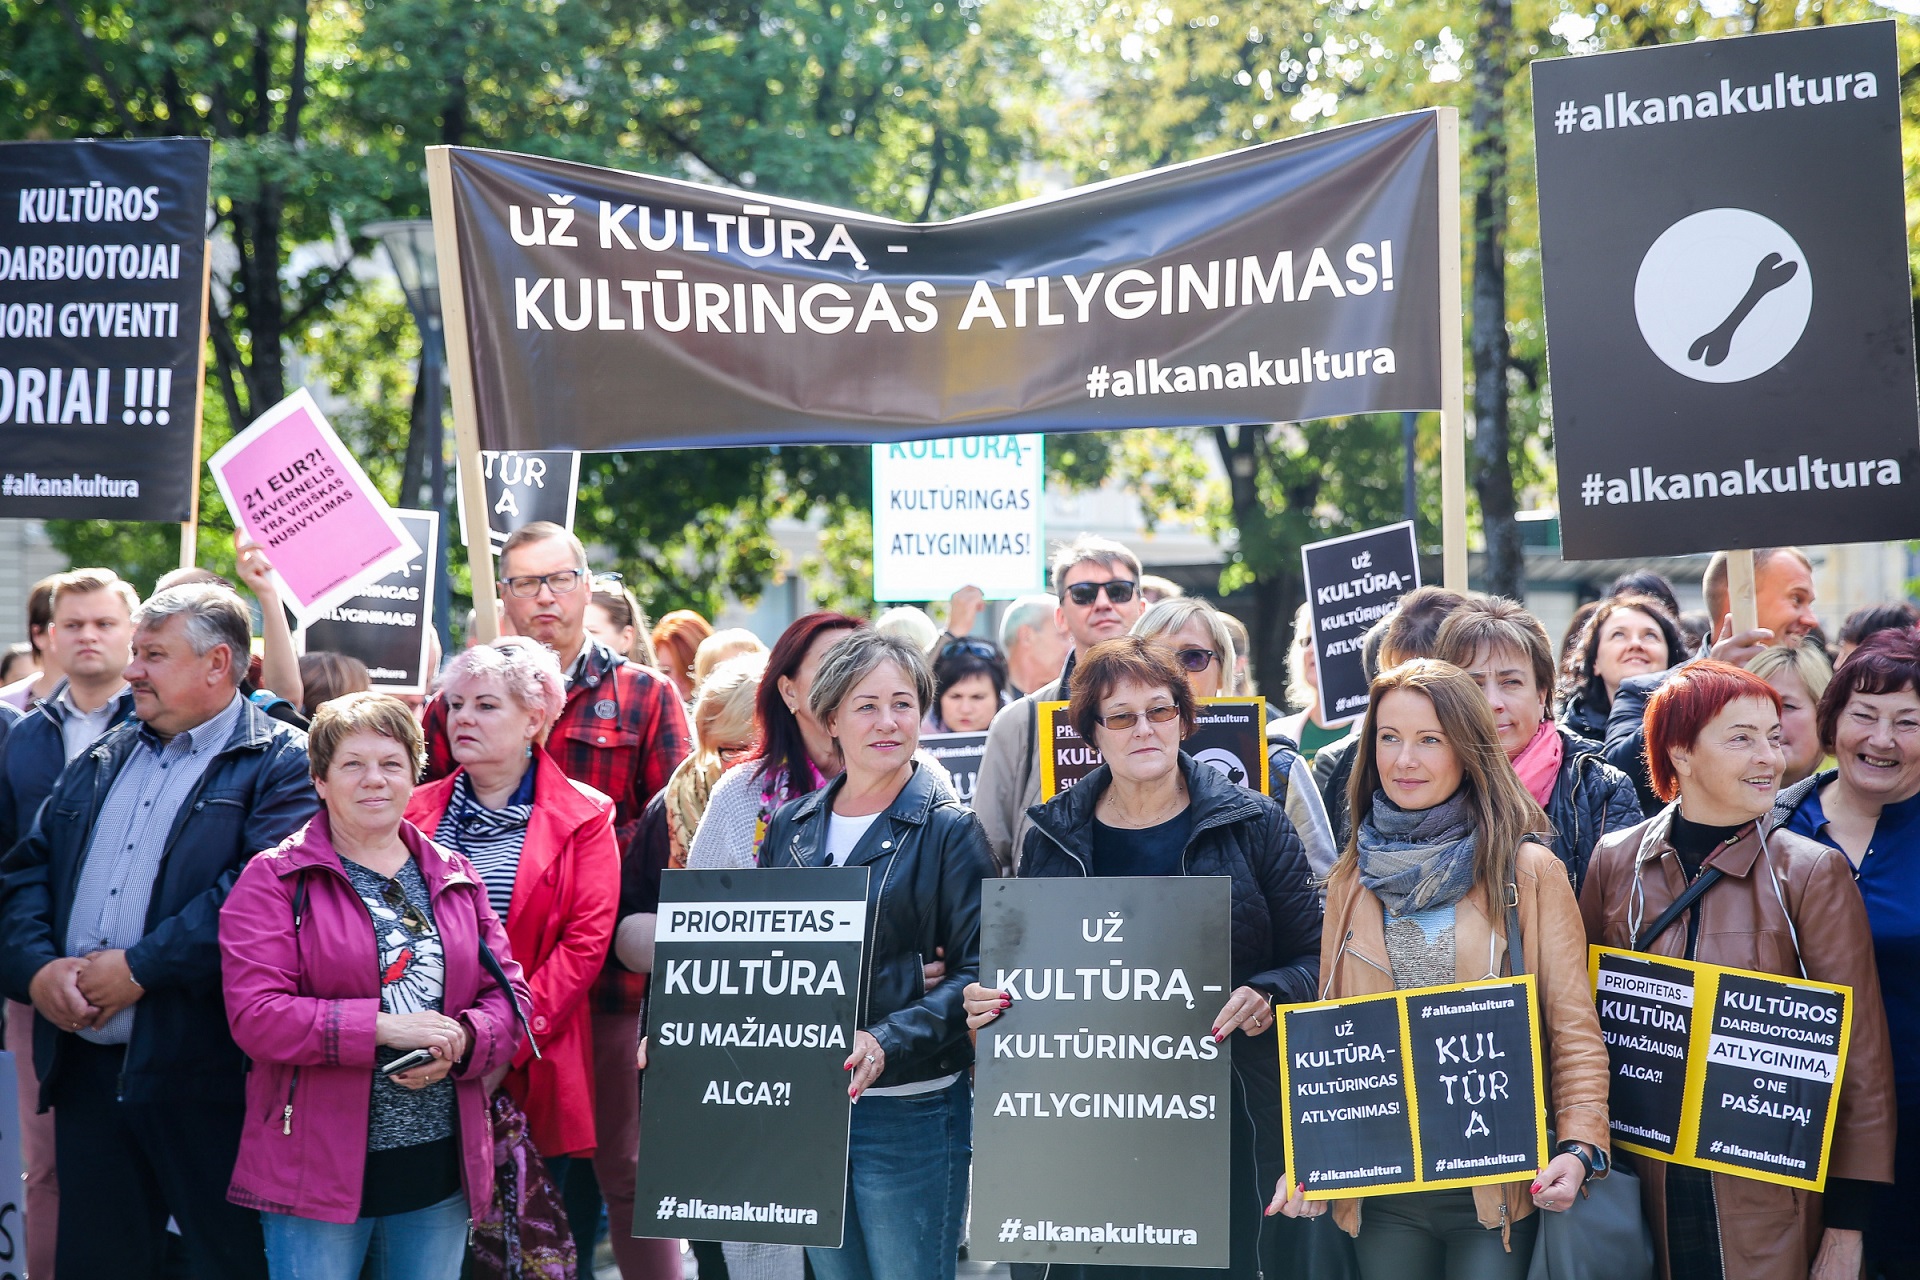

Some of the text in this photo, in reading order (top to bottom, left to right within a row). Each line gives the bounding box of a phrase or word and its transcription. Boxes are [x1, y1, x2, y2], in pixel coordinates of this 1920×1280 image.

[1554, 70, 1878, 135] #alkanakultura
[18, 180, 160, 224] KULTŪROS
[598, 200, 870, 271] KULTŪRĄ
[514, 239, 1395, 335] KULTŪRINGAS ATLYGINIMAS!
[59, 302, 179, 338] GYVENTI
[1086, 345, 1396, 399] #alkanakultura
[2, 472, 140, 498] #alkanakultura
[243, 448, 326, 510] 21 EUR?!
[1581, 454, 1902, 507] #alkanakultura
[252, 465, 335, 525] SKVERNELIS
[890, 484, 1030, 510] KULTŪRINGAS
[259, 517, 286, 535] YRA
[268, 490, 354, 548] NUSIVYLIMAS
[891, 532, 1031, 555] ATLYGINIMAS!
[1351, 550, 1373, 570] UŽ
[1193, 713, 1249, 724] anakultura
[1082, 911, 1124, 943] UŽ
[664, 950, 846, 996] KULTŪRA
[1421, 998, 1515, 1019] #alkanakultura
[1601, 999, 1687, 1034] KULTŪRA
[1723, 990, 1838, 1025] KULTŪROS
[659, 1016, 847, 1049] SU MAŽIAUSIA
[1334, 1020, 1354, 1037] UŽ
[1720, 1016, 1834, 1046] DARBUOTOJAMS
[993, 1027, 1219, 1061] KULTŪRINGAS
[1435, 1031, 1505, 1065] KUL
[1618, 1033, 1684, 1060] MAŽIAUSIA
[1619, 1063, 1663, 1084] ALGA?!
[1713, 1042, 1831, 1079] ATLYGINIMĄ,
[701, 1080, 791, 1107] ALGA?!
[1297, 1073, 1398, 1096] KULTŪRINGAS
[1439, 1068, 1509, 1105] TŪR
[1753, 1077, 1788, 1095] O NE
[993, 1092, 1216, 1120] ATLYGINIMAS!
[1300, 1101, 1400, 1124] ATLYGINIMAS!
[1721, 1093, 1811, 1127] PAŠALPĄ!
[1464, 1109, 1490, 1139] A
[1610, 1119, 1671, 1144] alkanakultura
[1435, 1152, 1526, 1172] #alkanakultura
[1709, 1140, 1806, 1170] #alkanakultura
[1309, 1164, 1402, 1183] #alkanakultura
[656, 1196, 818, 1225] #alkanakultura
[998, 1218, 1198, 1245] #alkanakultura
